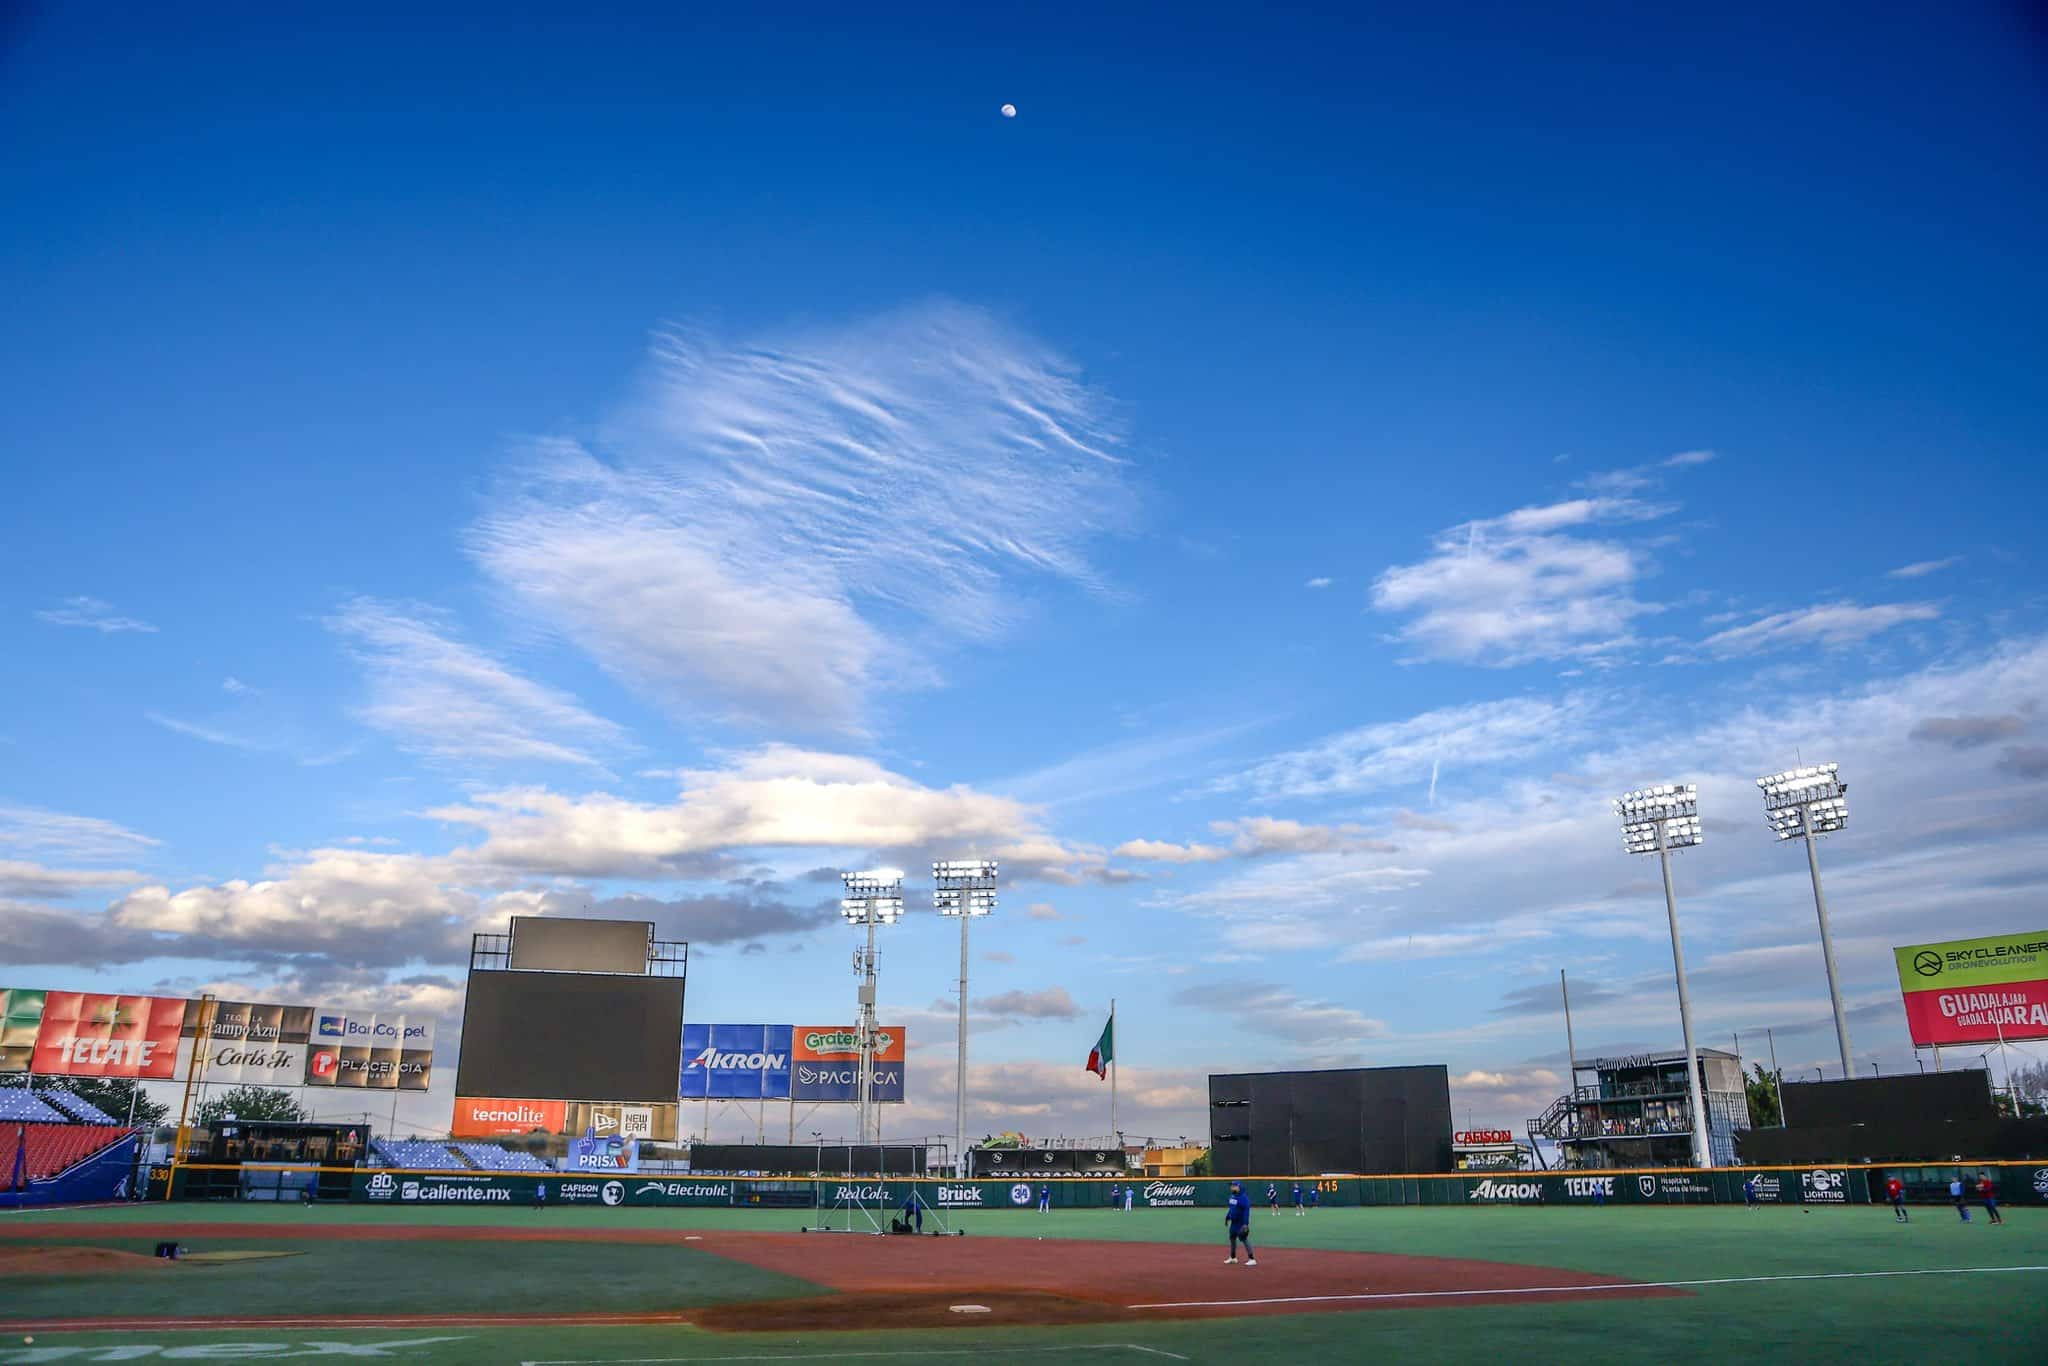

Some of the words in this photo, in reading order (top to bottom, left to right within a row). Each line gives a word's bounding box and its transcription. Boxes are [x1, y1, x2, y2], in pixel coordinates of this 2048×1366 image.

[1939, 993, 2027, 1017] GUADALAJARA
[225, 1013, 263, 1023] TEQLA
[1958, 1002, 2048, 1027] GUADALAJARA
[349, 1021, 427, 1040] BanCoppel
[806, 1031, 863, 1048] Grater
[56, 1037, 159, 1066] TECATE
[689, 1047, 786, 1070] AKRON
[340, 1060, 423, 1073] PLACENCIA
[473, 1105, 544, 1123] tecnolite
[625, 1114, 648, 1123] NEW
[625, 1123, 648, 1132] ERA
[579, 1155, 619, 1168] PRISA
[372, 1175, 392, 1188] 80
[1318, 1181, 1338, 1192] 415
[1470, 1180, 1543, 1199] AKRON
[1565, 1177, 1615, 1196] TECATE
[419, 1184, 511, 1200] caliente.mx
[667, 1184, 728, 1196] Electrolit
[938, 1185, 982, 1201] Brück
[1144, 1181, 1195, 1199] Caliente
[1805, 1191, 1844, 1199] LIGHTING
